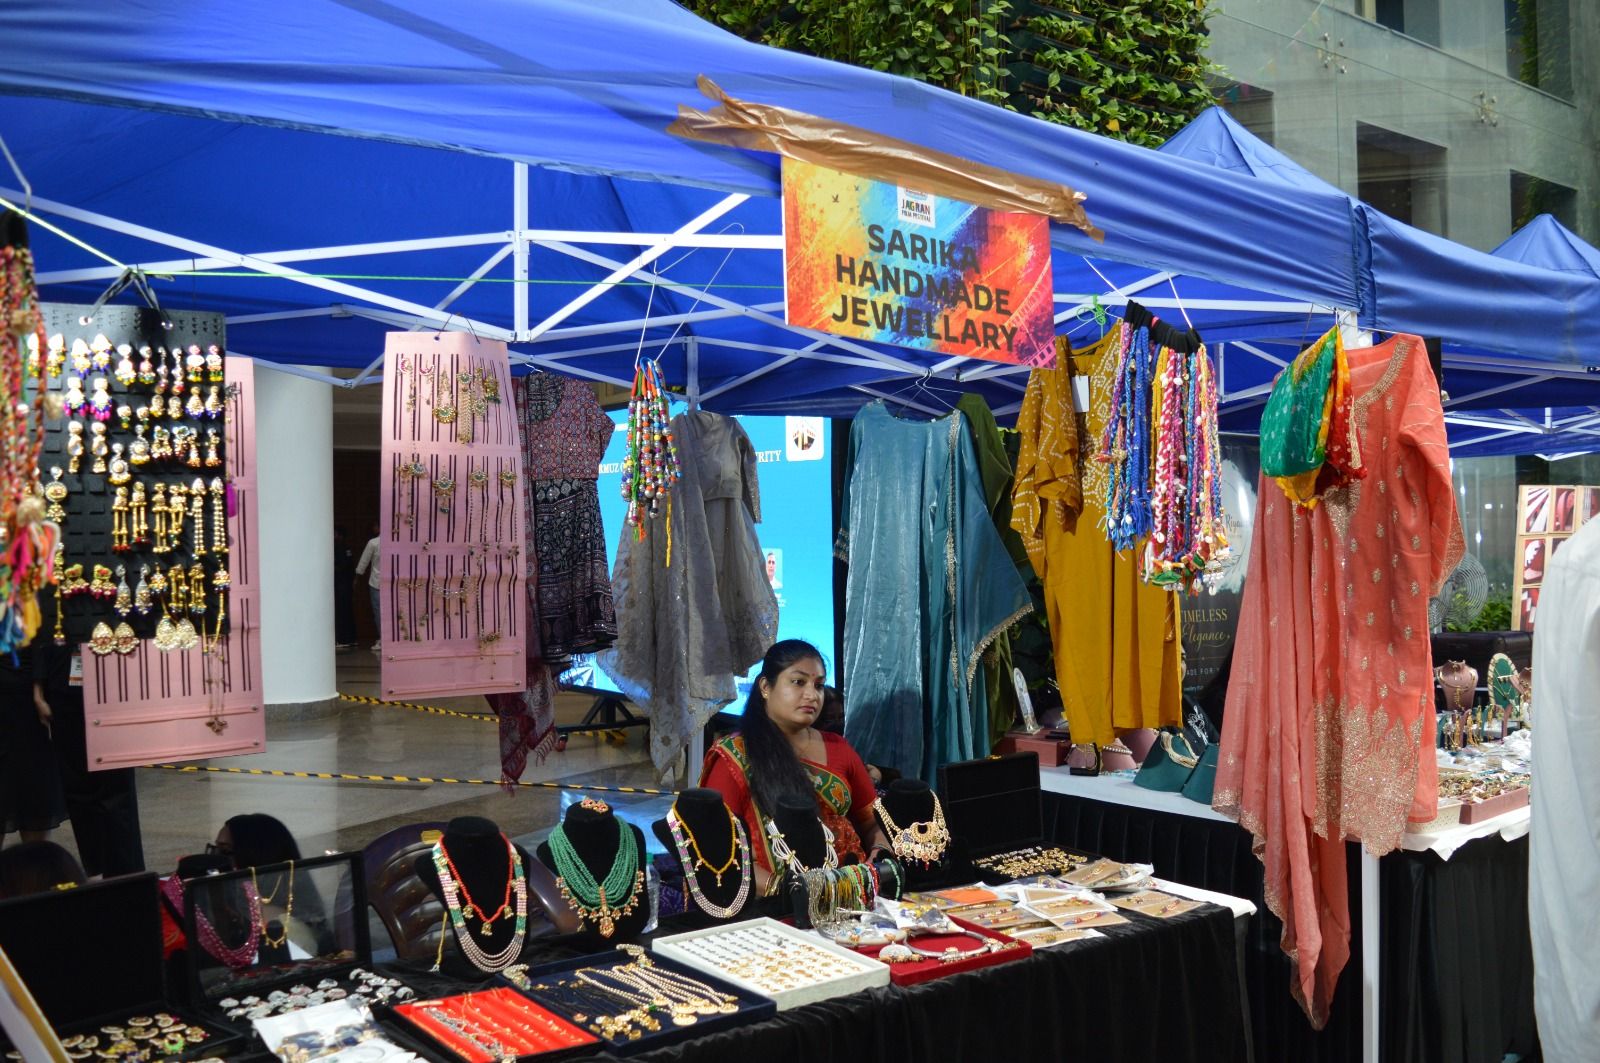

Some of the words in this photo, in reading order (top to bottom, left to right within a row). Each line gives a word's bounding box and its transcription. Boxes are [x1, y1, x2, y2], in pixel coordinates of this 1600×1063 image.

[902, 198, 931, 215] JAGRAN
[902, 209, 912, 218] FILM
[912, 212, 931, 222] FESTIVAL
[868, 224, 980, 274] SARIKA
[836, 254, 1012, 316] HANDMADE
[832, 294, 1018, 351] JEWELLARY
[1182, 622, 1226, 652] Elegance
